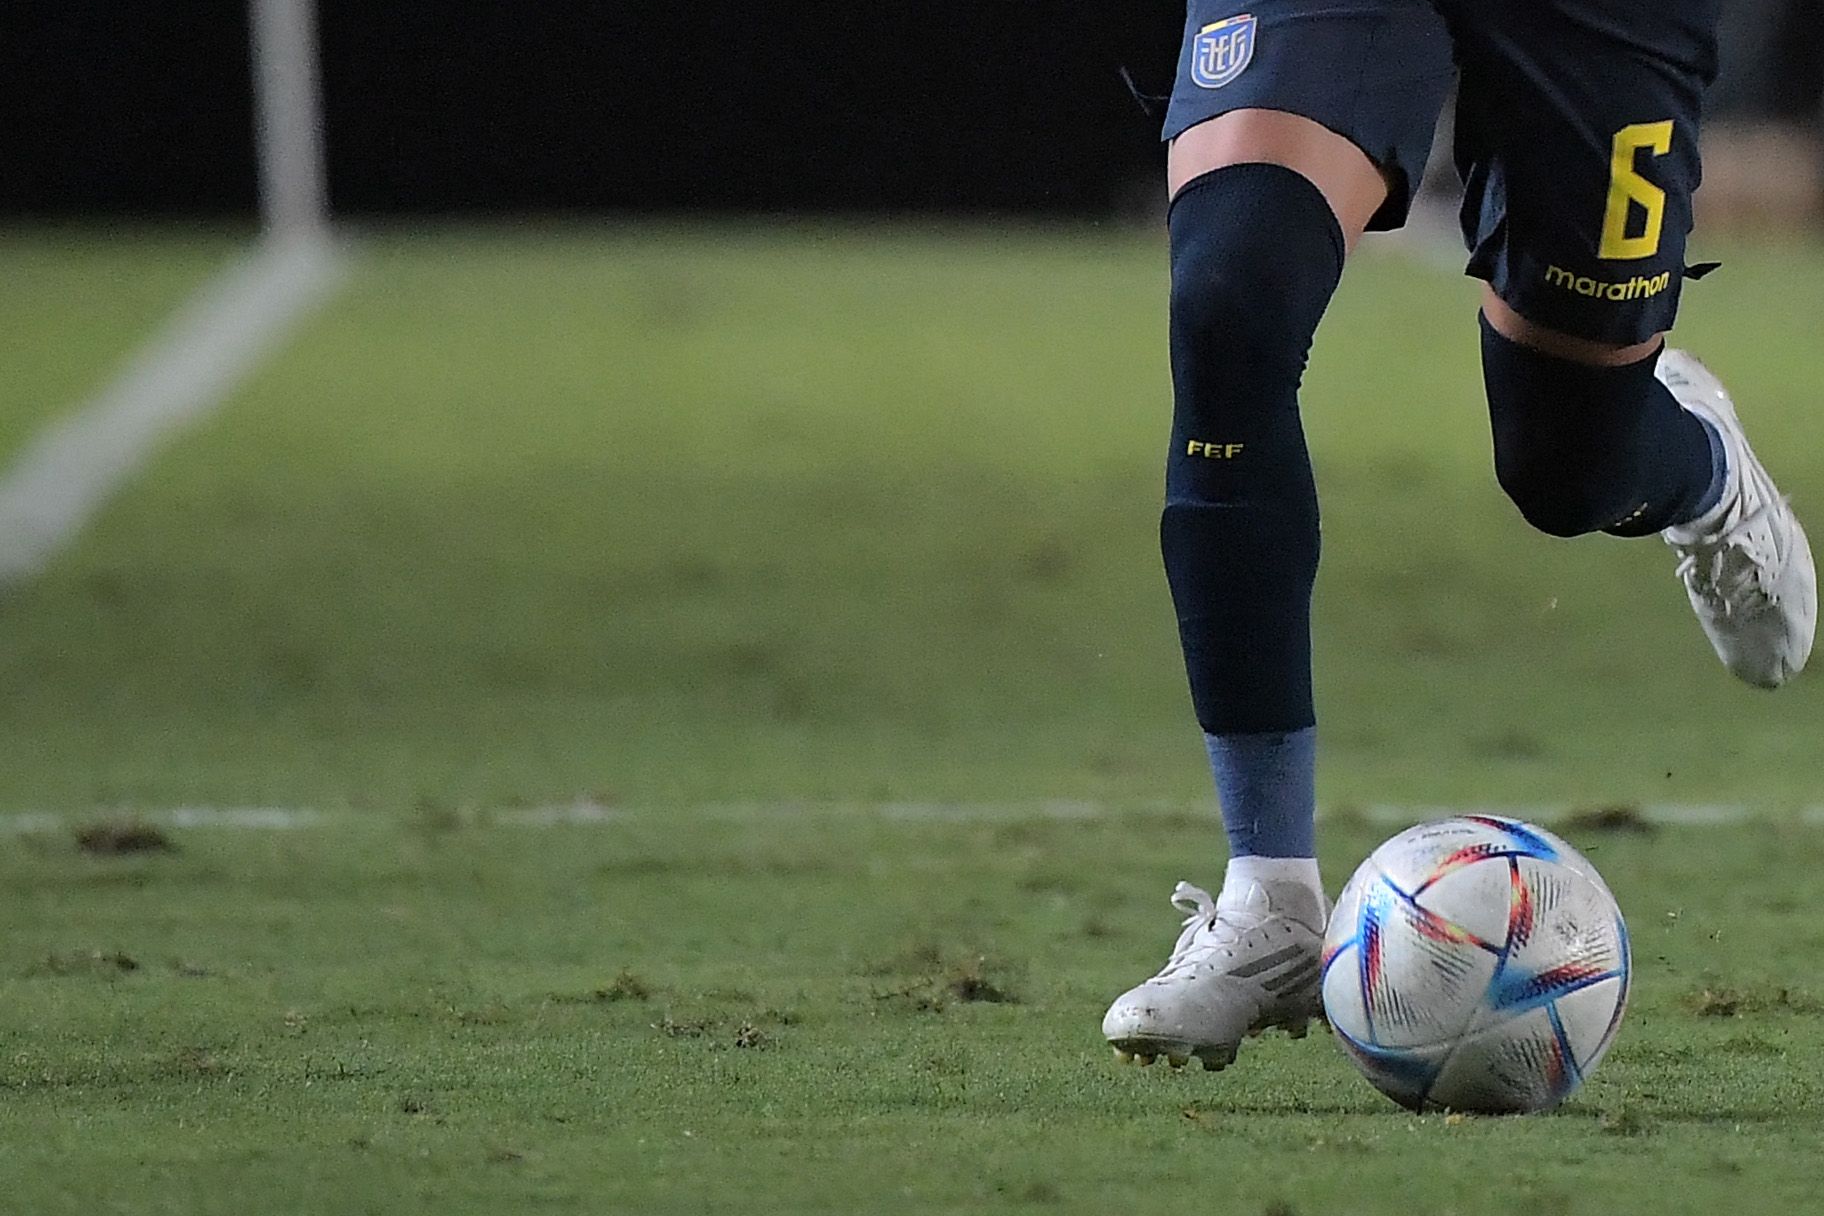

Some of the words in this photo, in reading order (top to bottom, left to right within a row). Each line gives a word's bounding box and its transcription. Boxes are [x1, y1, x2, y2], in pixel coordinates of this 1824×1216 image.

[1597, 119, 1675, 259] 6
[1544, 264, 1671, 301] marathon
[1186, 439, 1244, 459] FEF
